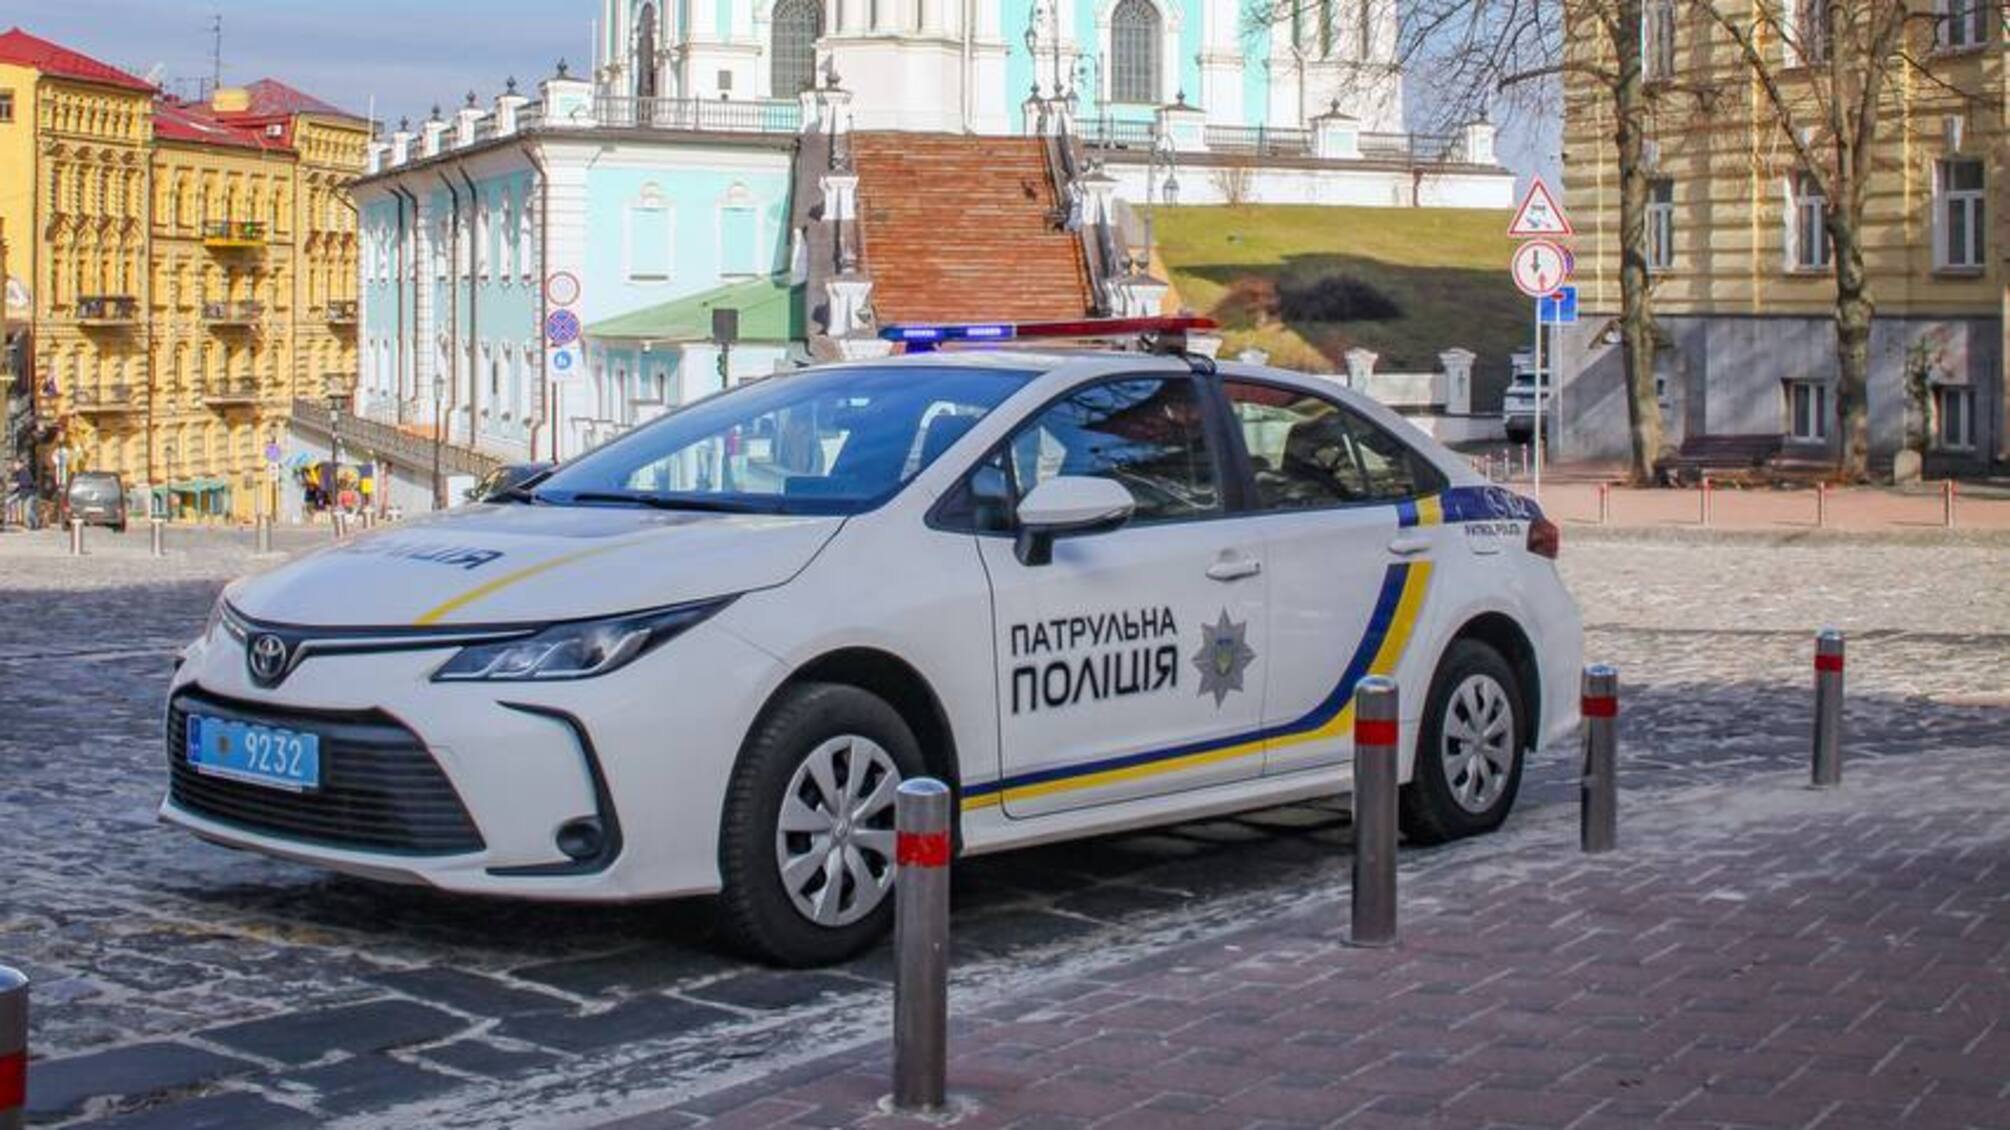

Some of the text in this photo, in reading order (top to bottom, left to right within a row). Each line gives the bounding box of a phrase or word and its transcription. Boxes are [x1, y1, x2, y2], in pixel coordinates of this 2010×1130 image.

[1011, 606, 1178, 656] ПАТРУЛЬНА
[1011, 645, 1179, 714] ПОЛІЦІЯ
[245, 732, 304, 777] 9232
